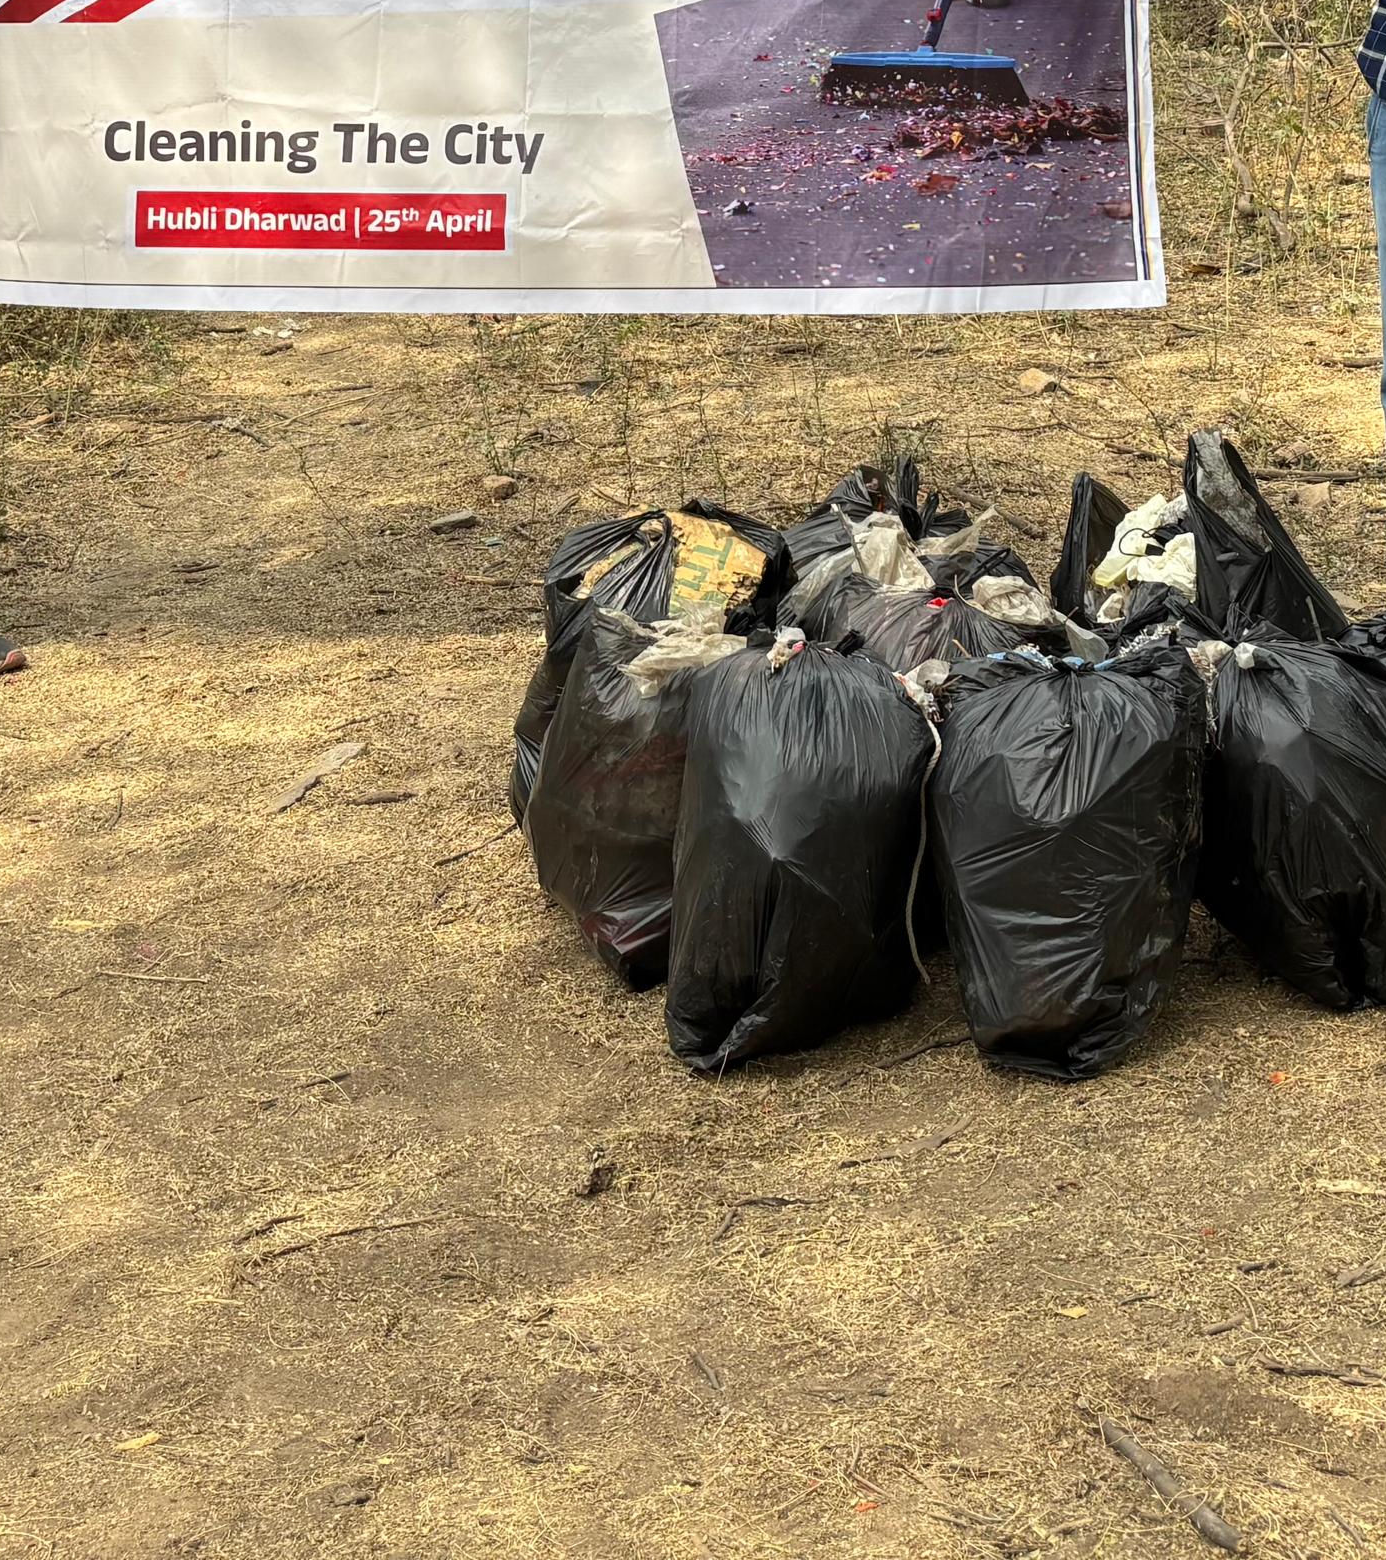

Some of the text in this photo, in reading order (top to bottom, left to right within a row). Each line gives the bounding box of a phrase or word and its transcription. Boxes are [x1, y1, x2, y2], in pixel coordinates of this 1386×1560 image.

[104, 120, 544, 175] Cleaning The City
[147, 206, 217, 231] Hubli
[224, 207, 346, 233] Dharwad
[367, 208, 420, 233] 25th
[425, 209, 493, 238] April
